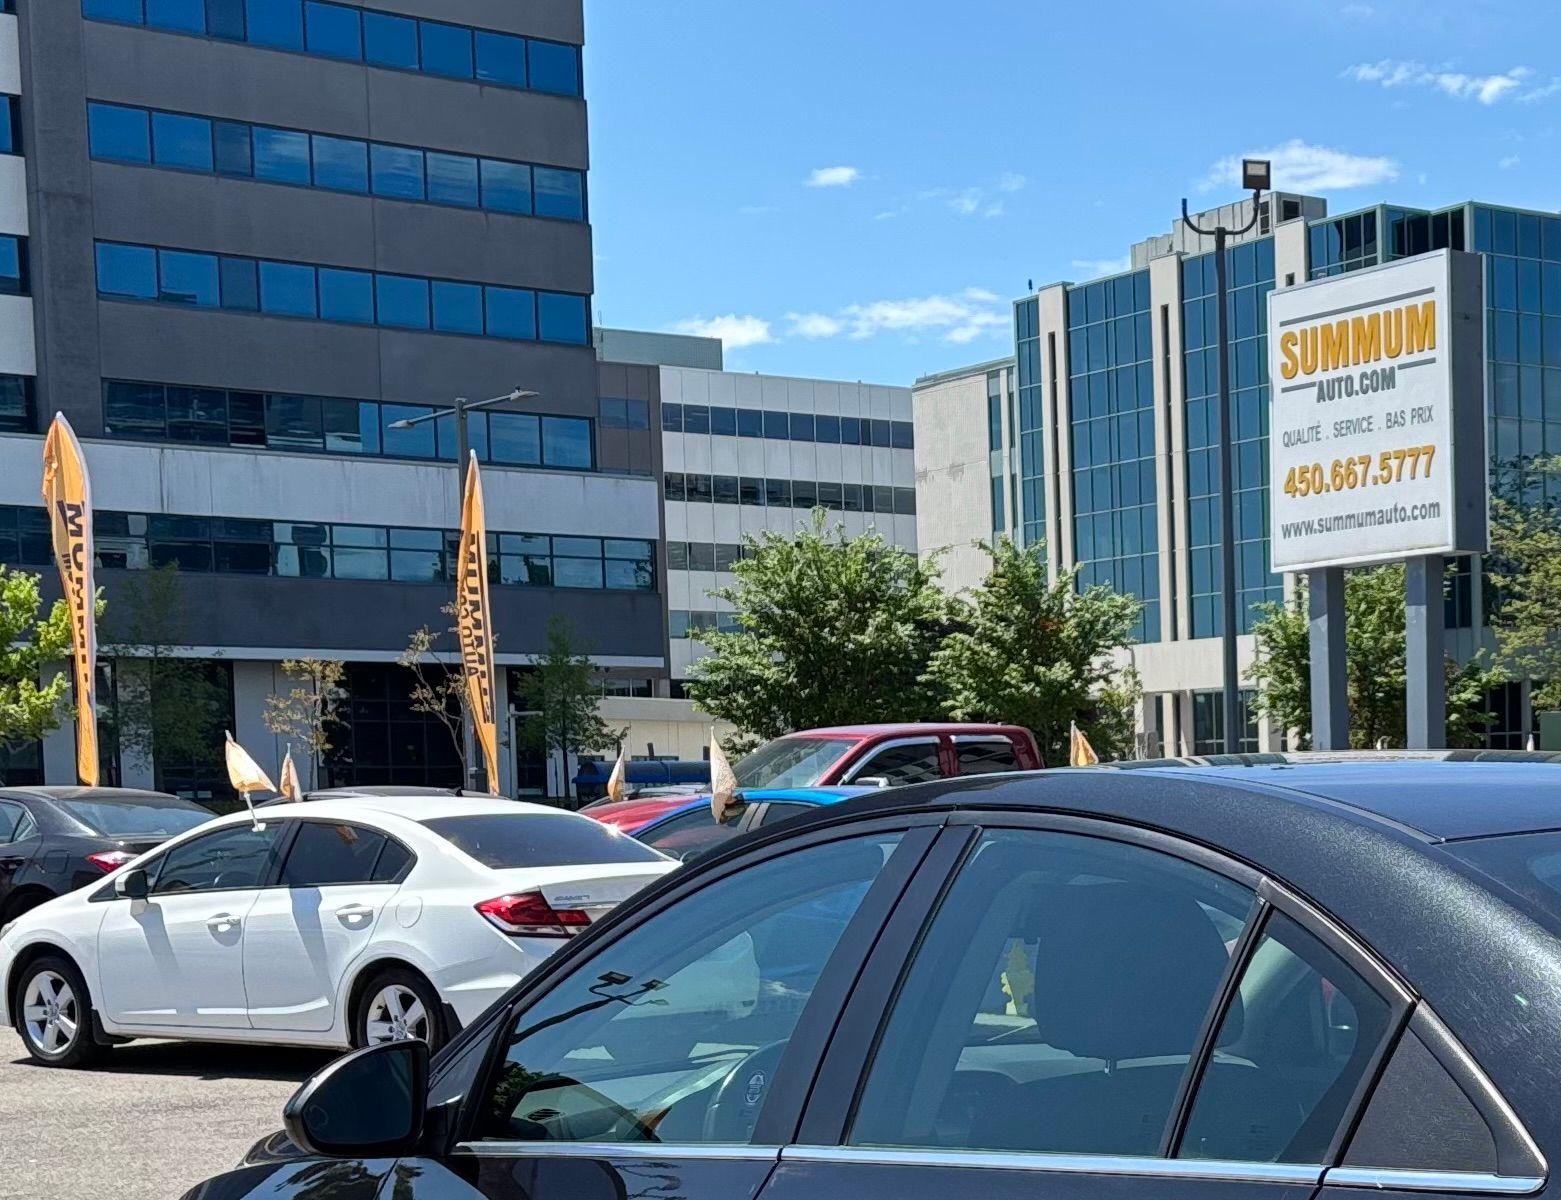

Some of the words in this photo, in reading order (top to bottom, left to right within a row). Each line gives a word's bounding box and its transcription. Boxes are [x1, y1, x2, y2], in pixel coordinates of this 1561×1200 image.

[1280, 300, 1436, 379] SUMMUM
[1316, 366, 1396, 403] AUTO.COM
[1283, 420, 1321, 447] QUALITÉ
[1333, 416, 1373, 438] SERVICE
[1386, 409, 1406, 429] BAS
[1411, 405, 1434, 425] PRIX
[1284, 445, 1436, 498] 450.667.5777
[1282, 501, 1440, 539] www.summumauto.com
